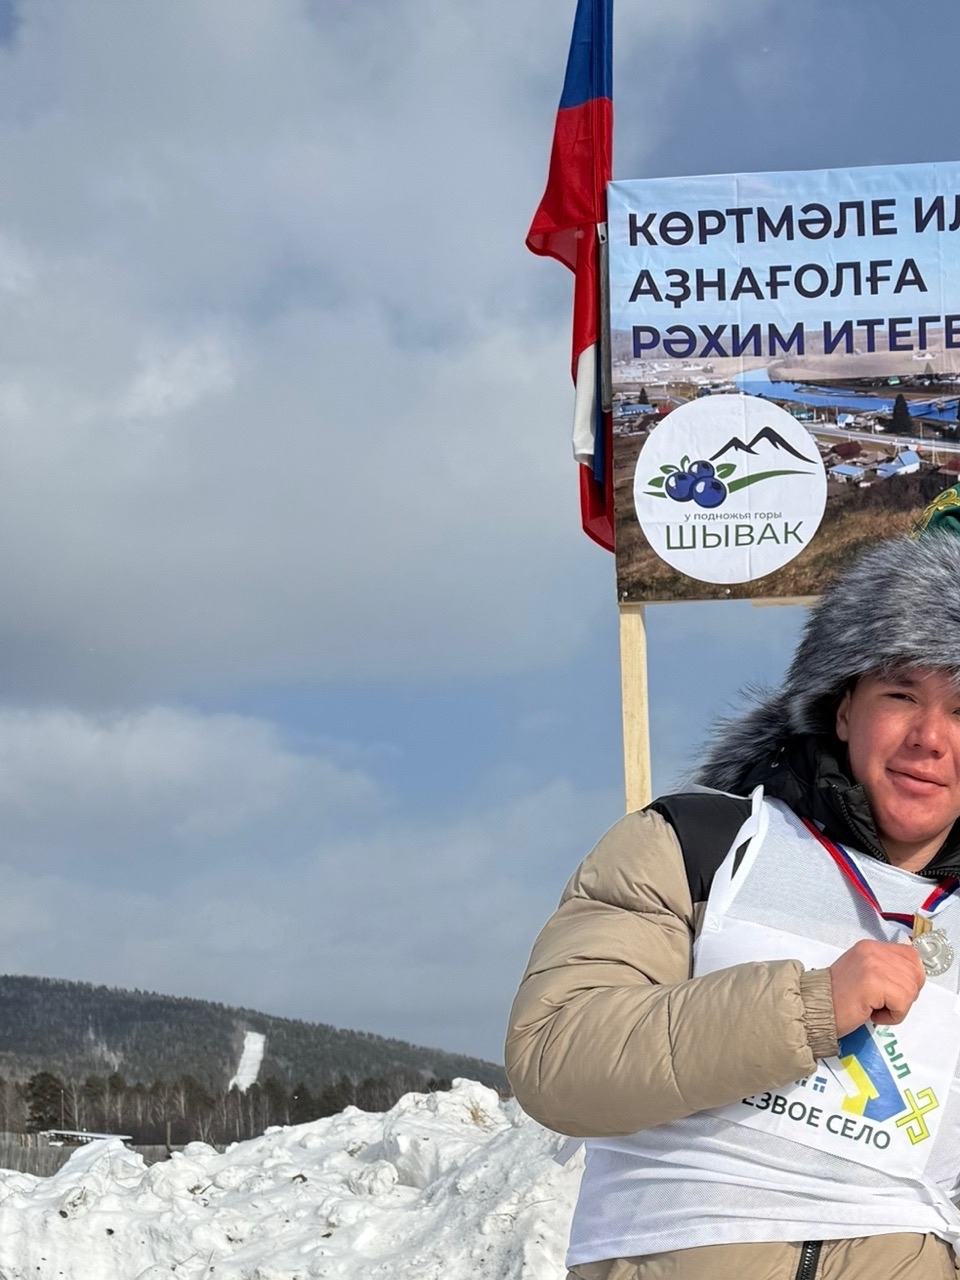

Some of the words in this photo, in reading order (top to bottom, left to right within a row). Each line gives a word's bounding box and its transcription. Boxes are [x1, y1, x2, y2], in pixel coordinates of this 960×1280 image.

[629, 198, 898, 247] КӨРТМӘЛЕ
[629, 258, 928, 308] АҘНАҒОЛҒА
[632, 322, 805, 359] РӘХИМ
[684, 513, 691, 522] у
[694, 512, 751, 522] подножья
[754, 511, 782, 520] горы
[666, 521, 804, 550] ШЫВАК
[872, 1023, 911, 1079] УЫЛ
[826, 1114, 891, 1150] СЕЛО
